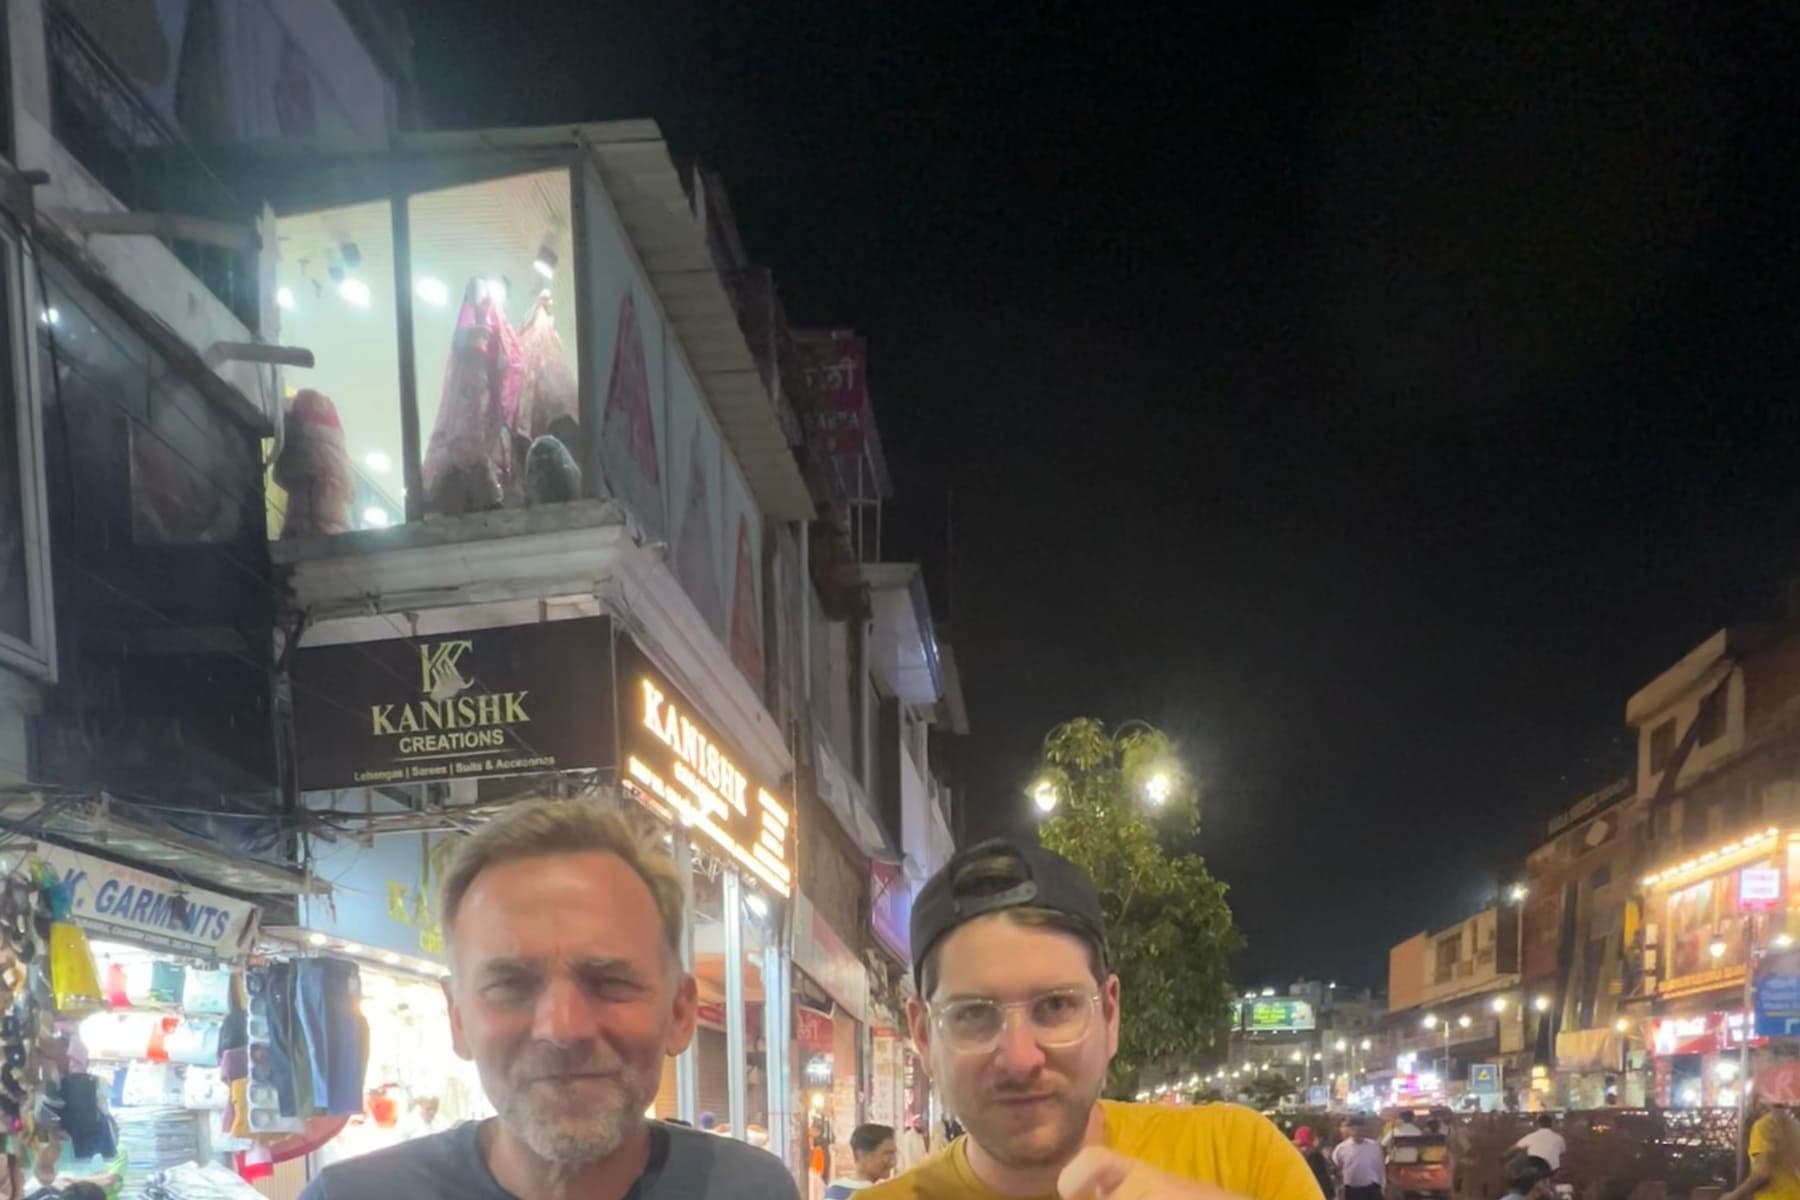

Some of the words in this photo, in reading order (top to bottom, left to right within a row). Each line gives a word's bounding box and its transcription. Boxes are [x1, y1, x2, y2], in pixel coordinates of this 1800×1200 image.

[371, 690, 530, 735] KANISHK
[399, 729, 504, 753] CREATIONS
[641, 677, 747, 817] KANISHK
